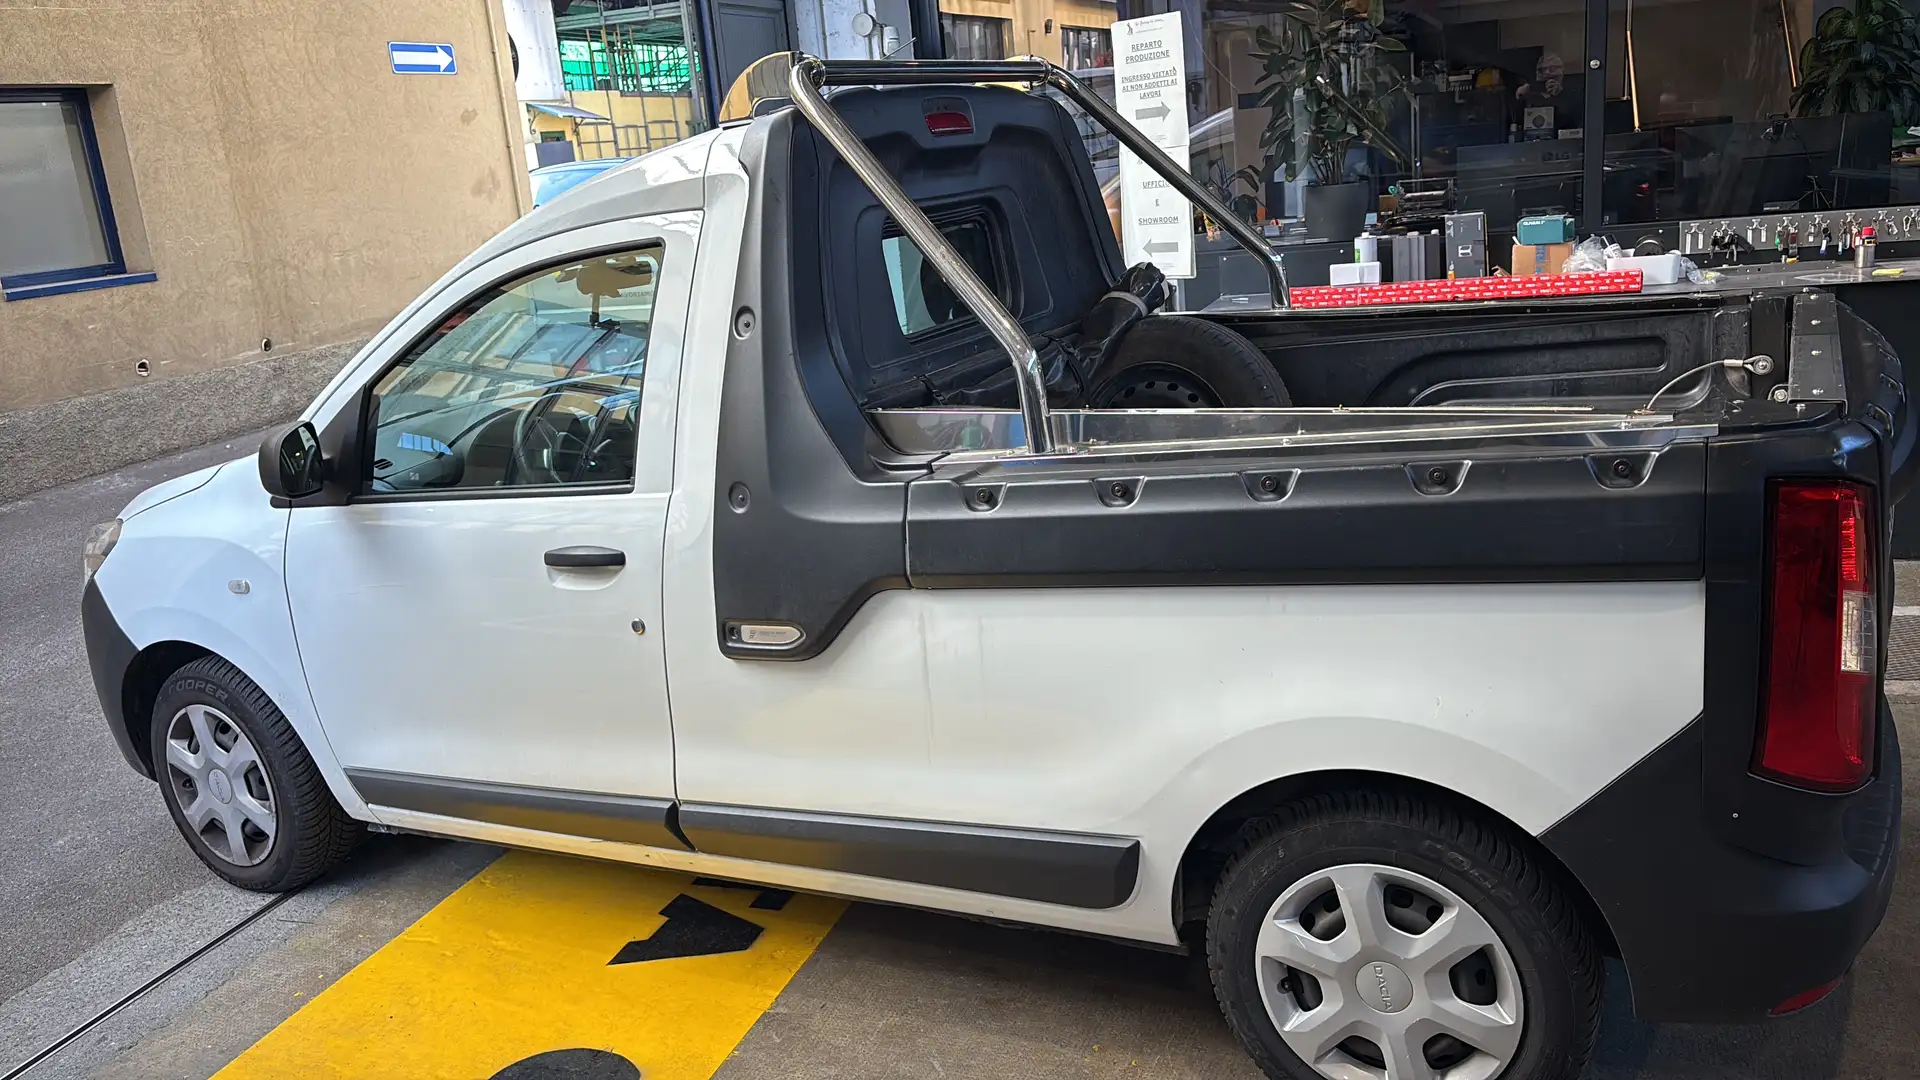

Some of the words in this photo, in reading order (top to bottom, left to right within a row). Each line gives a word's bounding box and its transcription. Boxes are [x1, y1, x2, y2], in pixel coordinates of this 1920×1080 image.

[1131, 40, 1162, 51] REPARTO
[1125, 50, 1170, 63] PRODUZIONE
[1121, 73, 1151, 83] INGRESSO
[1130, 83, 1143, 91] NON
[1144, 80, 1169, 89] ADDETTI
[1139, 90, 1161, 99] LAVORI
[1155, 199, 1160, 207] E
[1138, 216, 1179, 225] SHOWROOM
[1373, 965, 1393, 1011] DACIA
